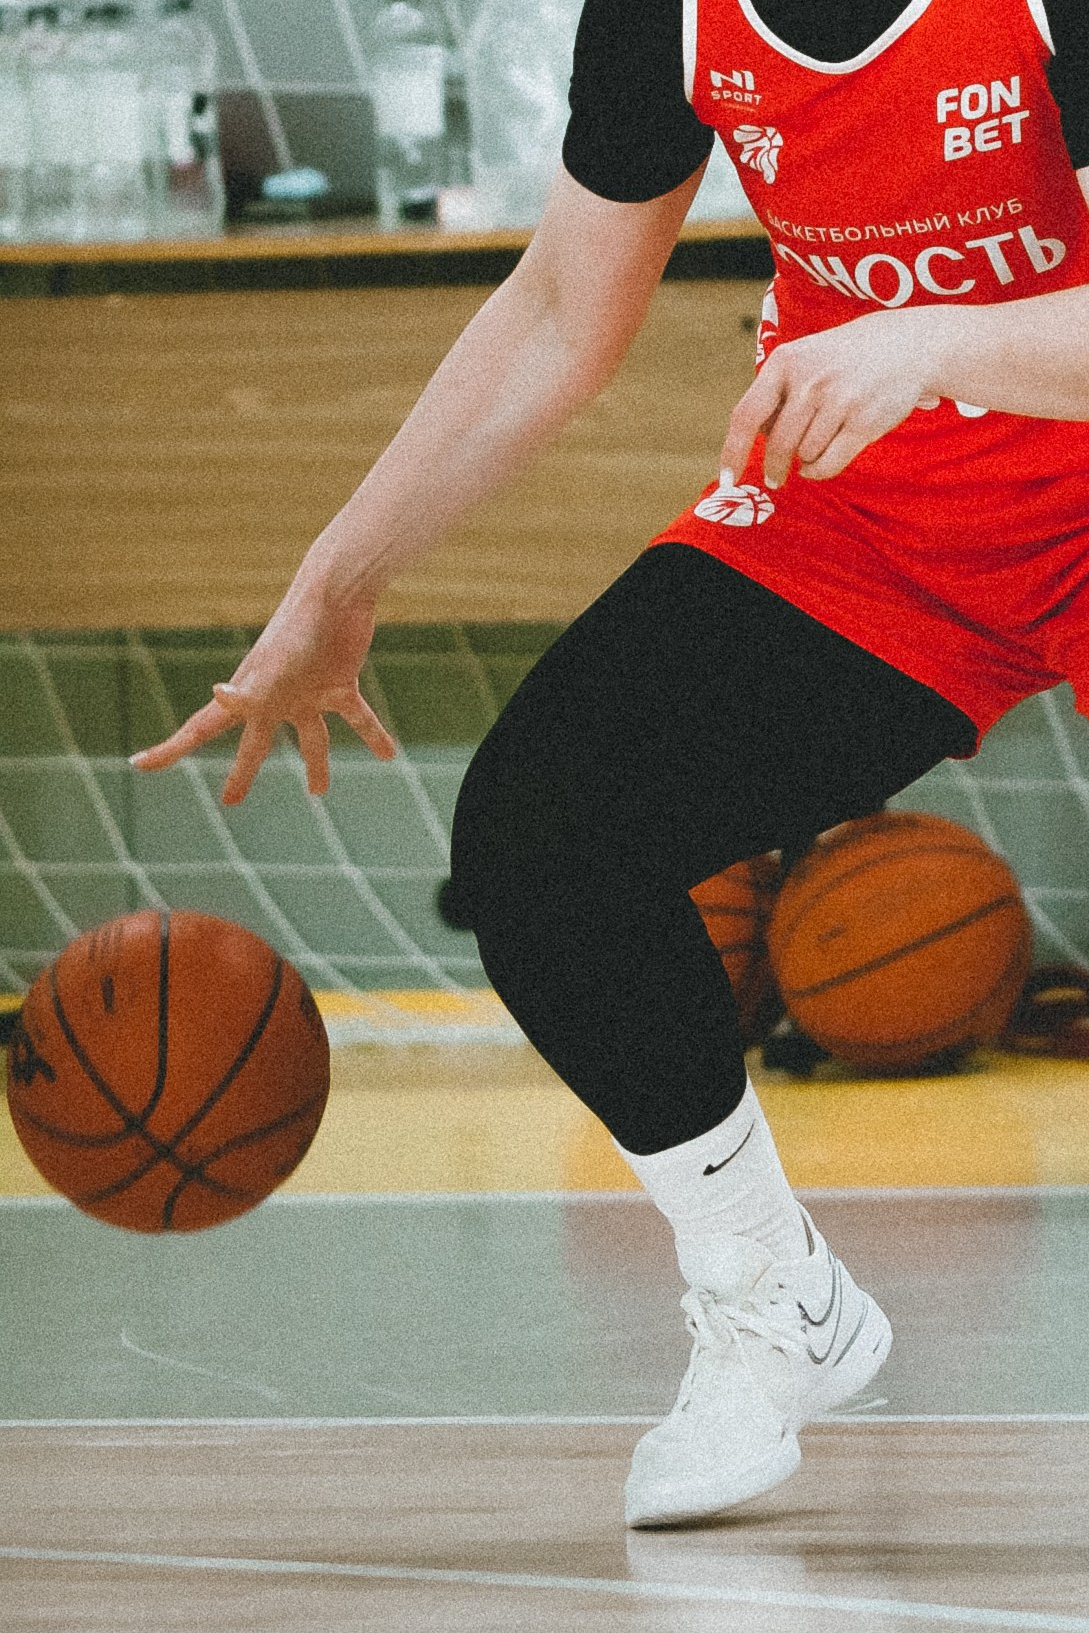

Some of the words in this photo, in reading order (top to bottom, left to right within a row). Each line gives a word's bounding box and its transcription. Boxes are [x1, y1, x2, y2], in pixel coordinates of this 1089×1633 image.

[711, 90, 762, 106] SPORT
[936, 75, 1020, 123] FON
[943, 109, 1030, 162] BET
[957, 198, 1023, 227] КЛУБ
